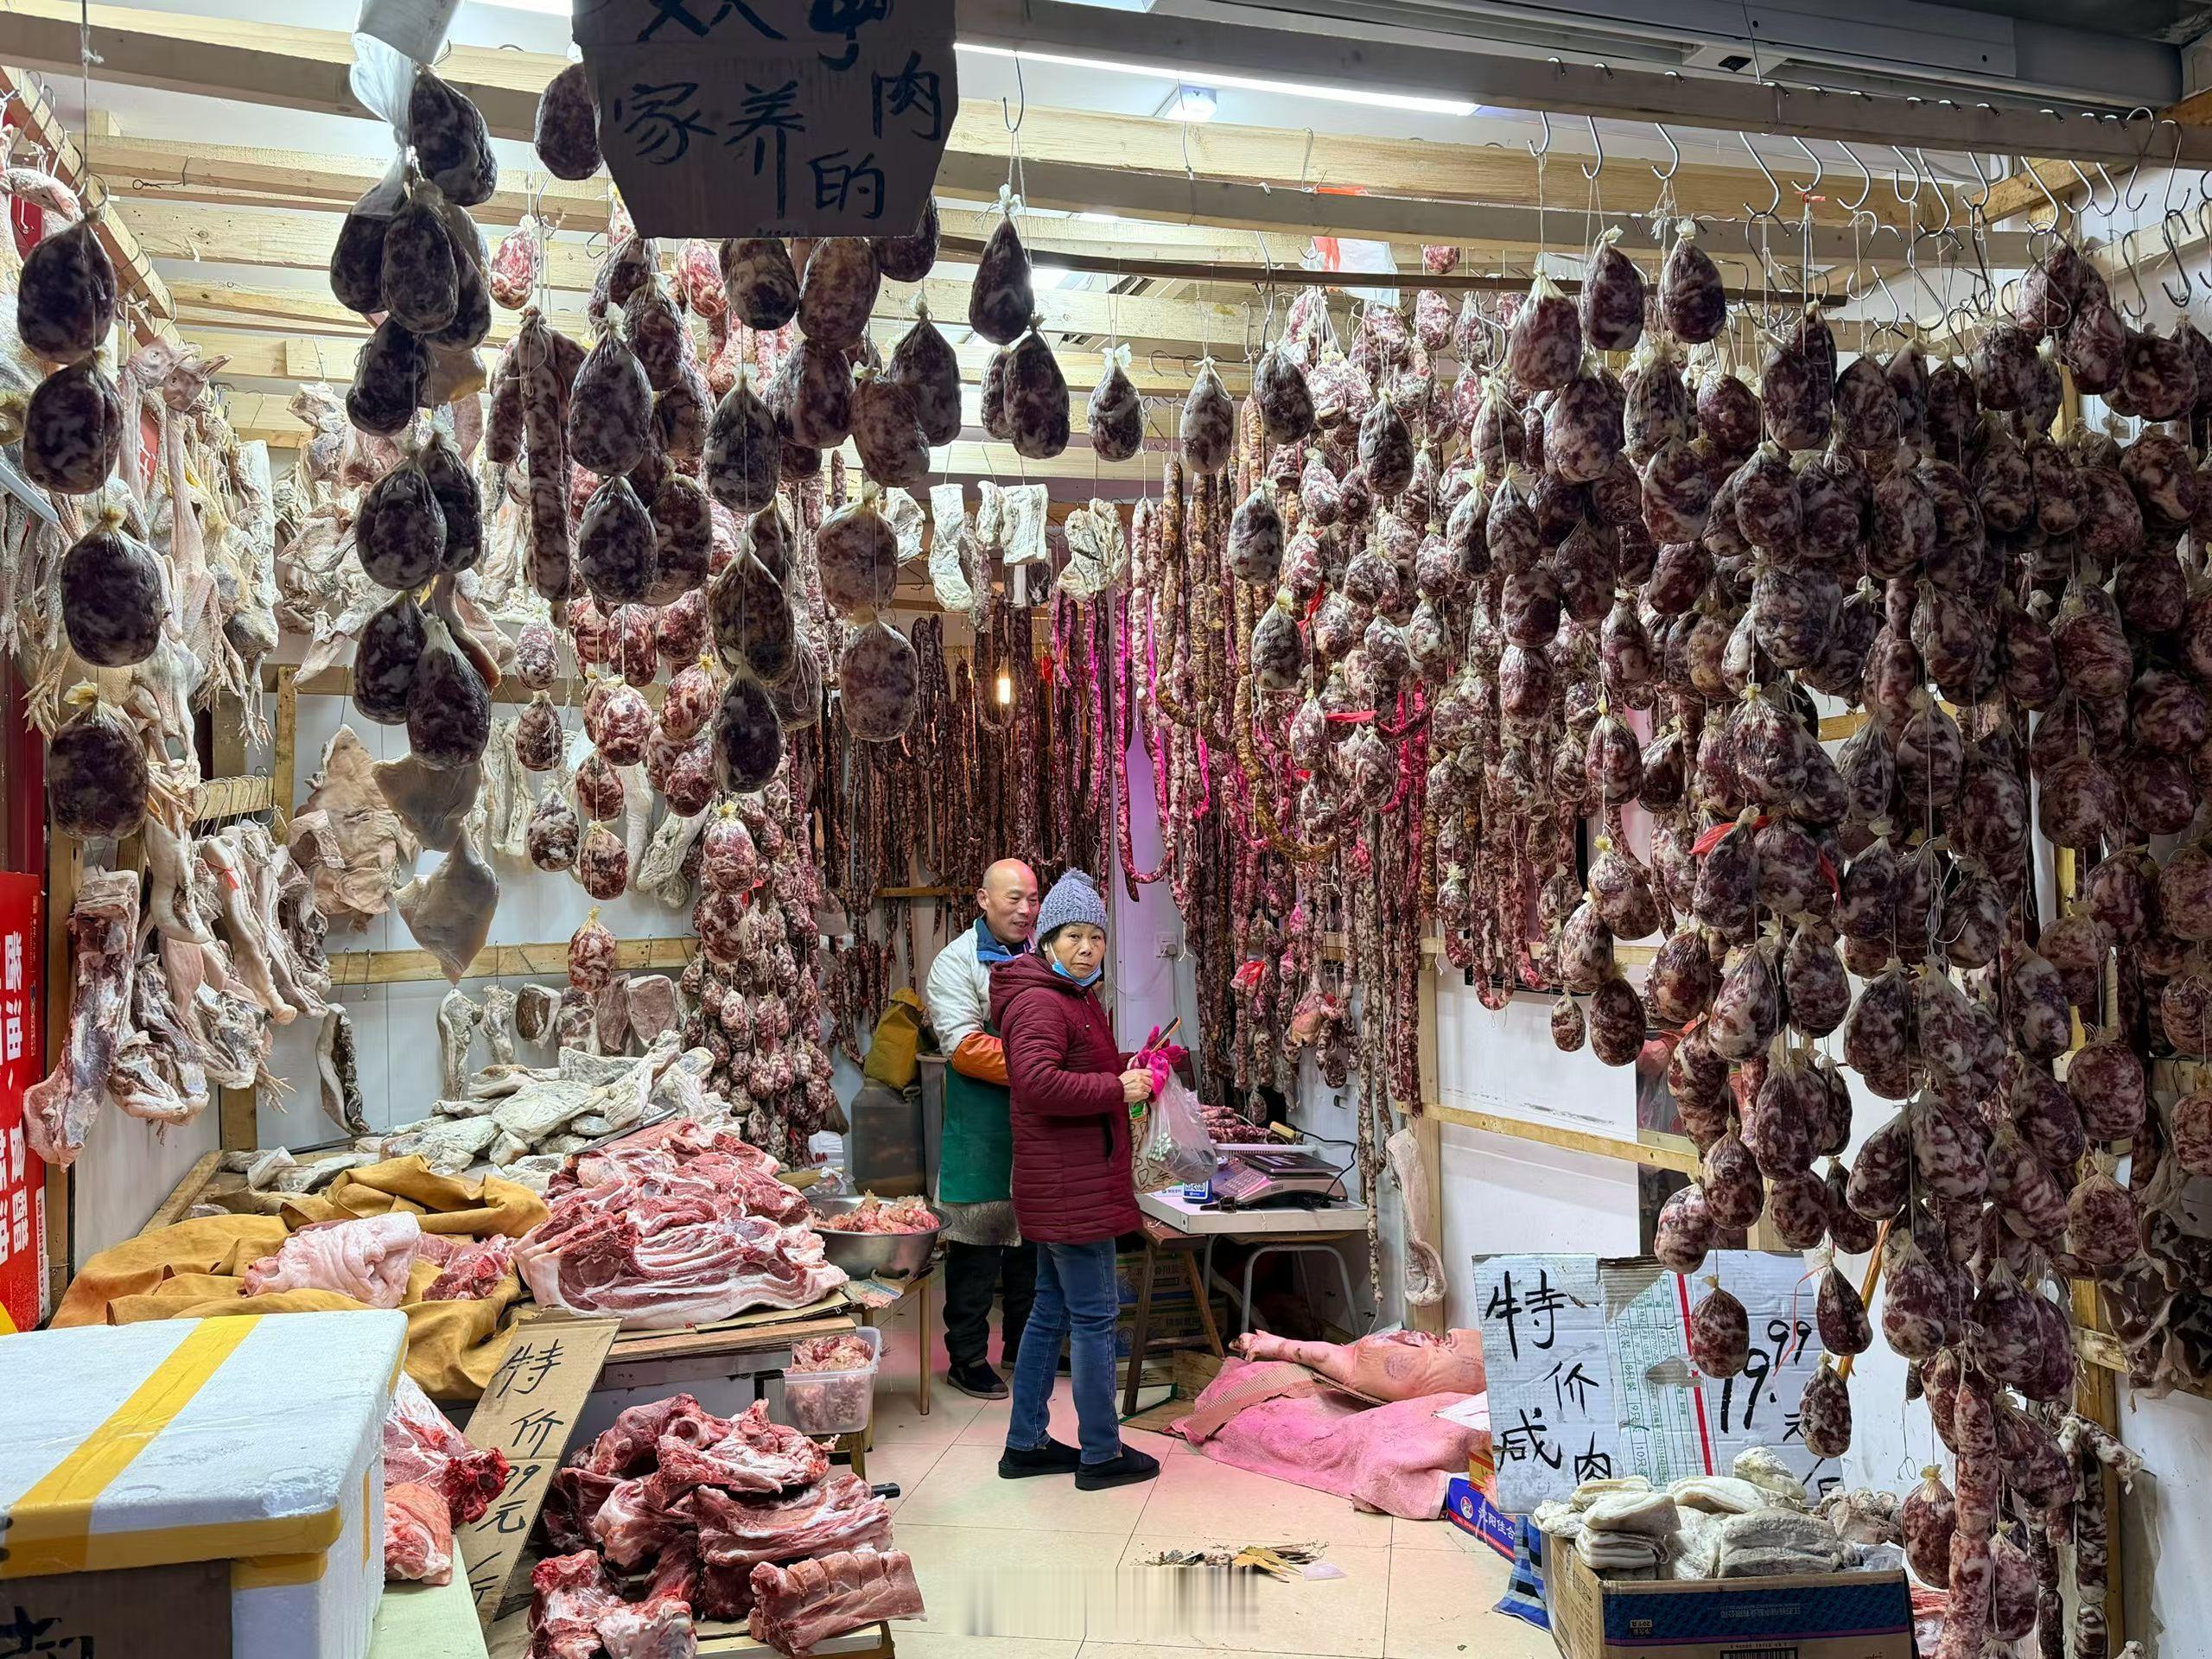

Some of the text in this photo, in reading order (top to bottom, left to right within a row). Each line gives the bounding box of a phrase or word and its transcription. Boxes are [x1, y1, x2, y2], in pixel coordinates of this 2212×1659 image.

[614, 80, 887, 220] 家养的
[1486, 1269, 1599, 1417] 特价
[1624, 1364, 1637, 1392] 8只装
